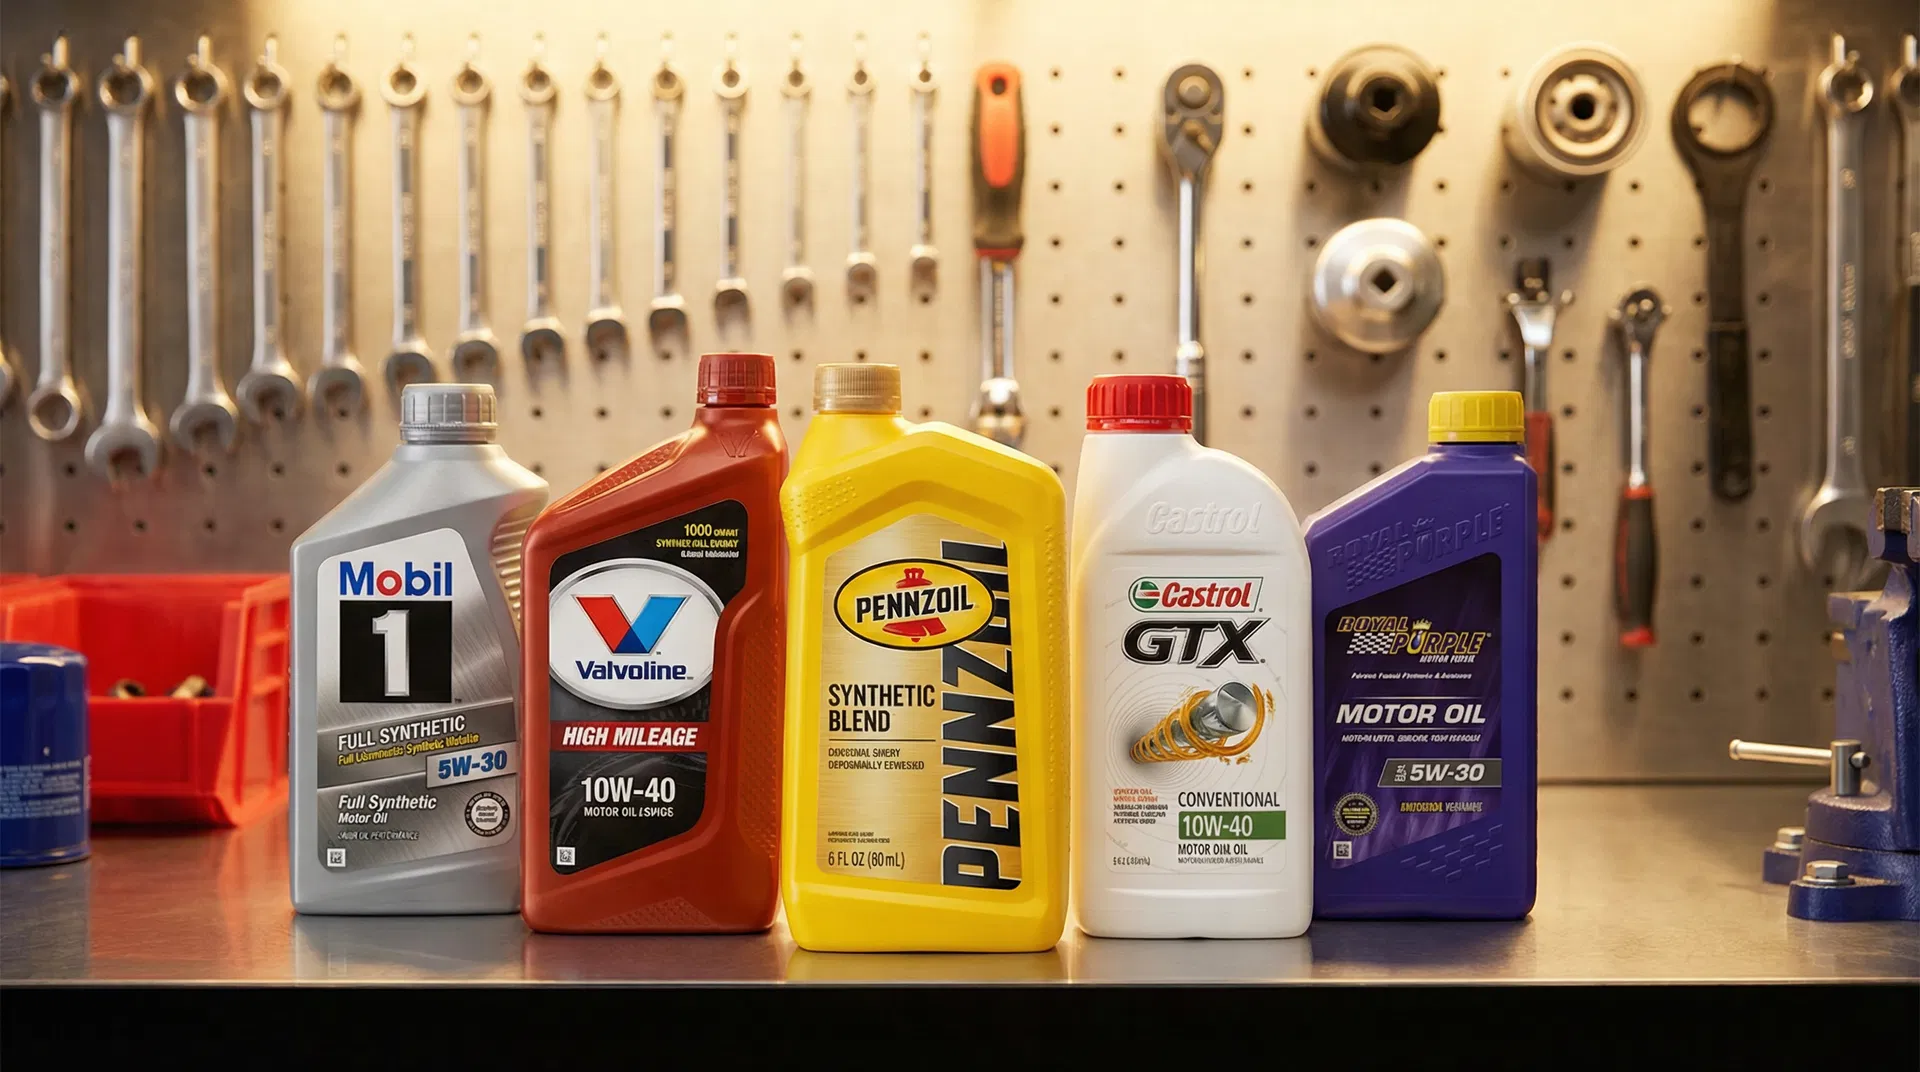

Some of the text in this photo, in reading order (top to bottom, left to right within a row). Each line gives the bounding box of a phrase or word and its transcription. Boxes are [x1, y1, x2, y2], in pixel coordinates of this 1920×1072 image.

[1147, 500, 1263, 535] Castrol
[684, 523, 713, 537] 1000
[1326, 505, 1504, 571] ROYAL PURPLE
[339, 561, 453, 597] Mobil
[855, 584, 974, 624] PENNZOIL
[1161, 581, 1253, 608] Castrol
[1337, 616, 1409, 632] ROYAL
[371, 608, 410, 697] 1
[1121, 617, 1272, 669] GTX
[1389, 630, 1486, 655] PURPLE
[575, 660, 687, 681] Valvoline
[827, 684, 936, 708] SYNTHETIC
[828, 709, 892, 733] BLEND
[1336, 703, 1487, 725] MOTOR OIL
[338, 715, 466, 752] FULL SYNTHETIC
[562, 726, 699, 747] HIGH MILEAGE
[437, 750, 508, 780] 5W-30
[1409, 763, 1486, 782] 5W-30
[580, 777, 676, 803] 10W-40
[1177, 791, 1281, 808] CONVENTIONAL
[338, 794, 437, 813] Full Synthetic
[583, 806, 620, 818] MOTOR
[621, 806, 638, 818] OIL
[338, 811, 389, 824] Motor Oil
[1182, 814, 1254, 837] 10W-40
[828, 851, 835, 867] 6
[837, 851, 849, 867] FL
[851, 851, 865, 867] OZ
[1178, 843, 1211, 855] MOTOR
[1233, 843, 1249, 855] OIL
